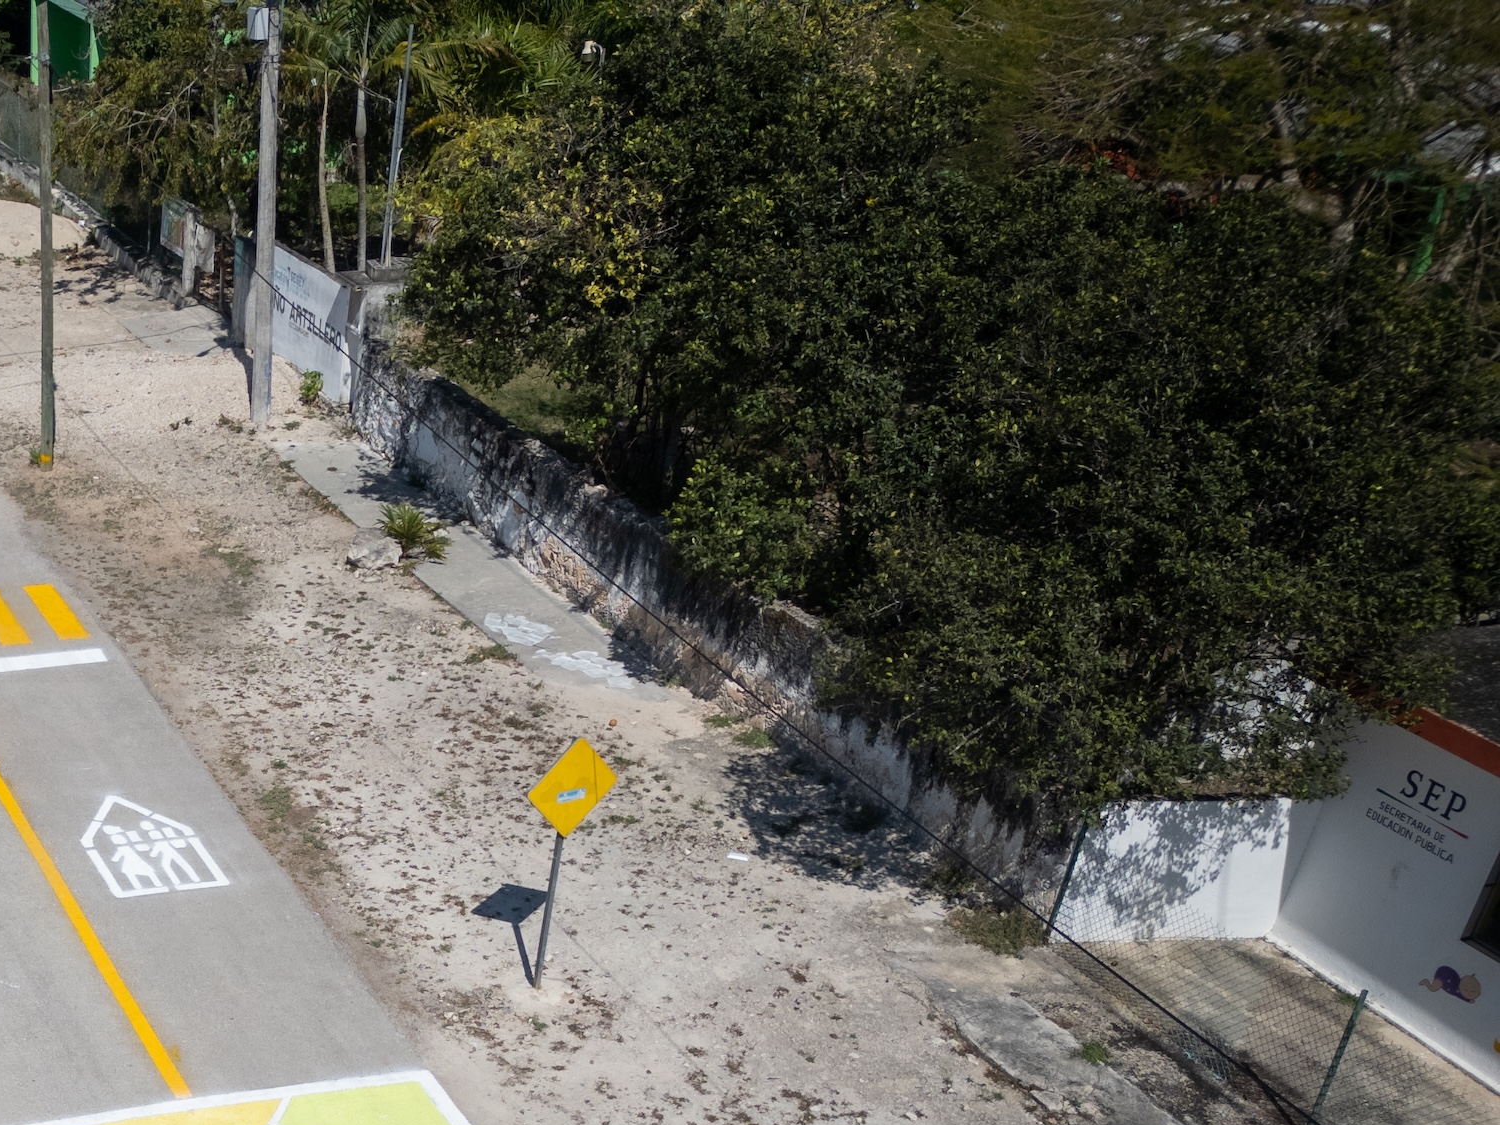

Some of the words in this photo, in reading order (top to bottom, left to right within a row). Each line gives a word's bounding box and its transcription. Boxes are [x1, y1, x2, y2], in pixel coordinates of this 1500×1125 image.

[289, 301, 342, 352] ARTILLERO
[1400, 770, 1467, 821] SEP
[1433, 831, 1446, 844] DE
